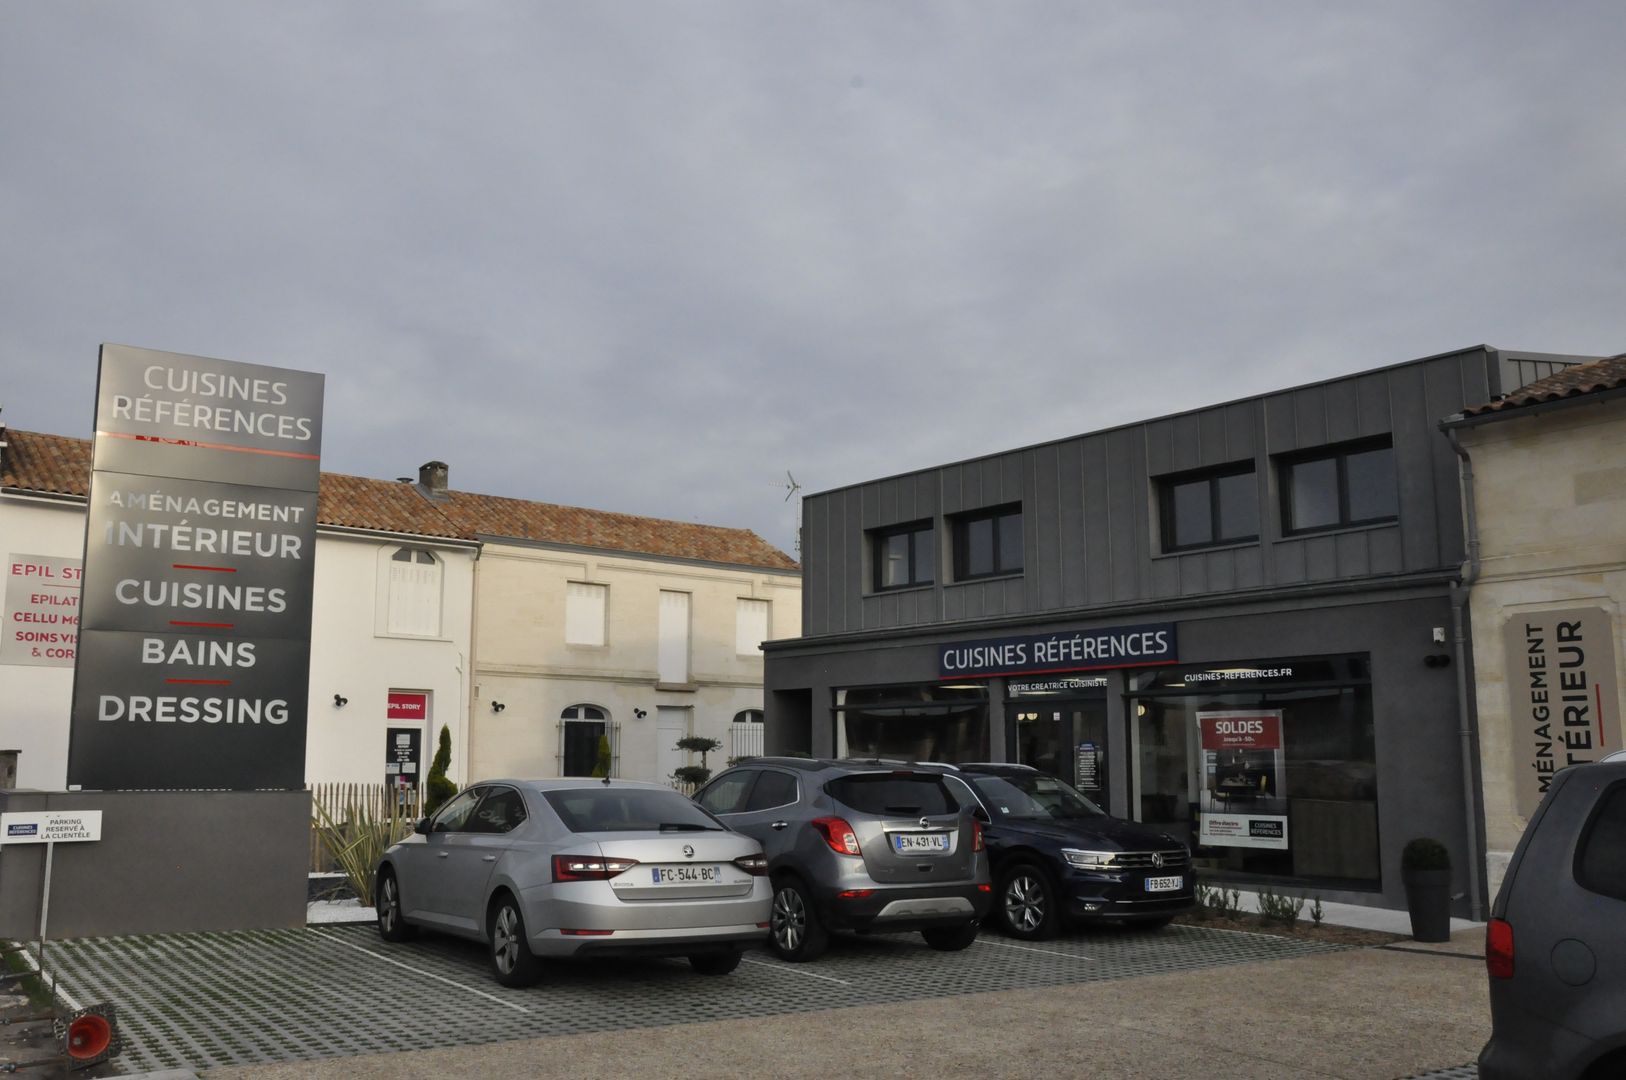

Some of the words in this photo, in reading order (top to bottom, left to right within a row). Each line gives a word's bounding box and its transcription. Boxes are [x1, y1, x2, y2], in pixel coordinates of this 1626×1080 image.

[144, 365, 288, 406] CUISINES
[112, 393, 312, 441] RÉFÉRENCES
[110, 490, 305, 524] AMÉNAGEMENT
[105, 518, 303, 560] INTÉRIEUR
[11, 563, 55, 578] EPIL
[62, 567, 82, 580] ST
[31, 594, 79, 607] EPILAT
[115, 578, 287, 613] CUISINES
[13, 612, 58, 624] CELLU
[15, 631, 58, 643] SOINS
[31, 647, 41, 658] &
[45, 648, 77, 659] COR
[141, 638, 257, 668] BAINS
[943, 643, 1027, 671] CUISINES
[1034, 631, 1168, 664] RÉFÉRENCES
[1008, 684, 1029, 692] VOTRE
[1069, 679, 1108, 689] CUISINISTE
[1184, 668, 1292, 682] CUISINES-REFERENCES.FR
[1557, 620, 1594, 767] TÉRIEUR
[98, 694, 289, 725] DRESSING
[1526, 623, 1555, 793] MÉNAGEMENT
[1215, 720, 1264, 735] SOLDES
[901, 836, 943, 848] EN-431-VL
[660, 868, 714, 882] FC-544-BC
